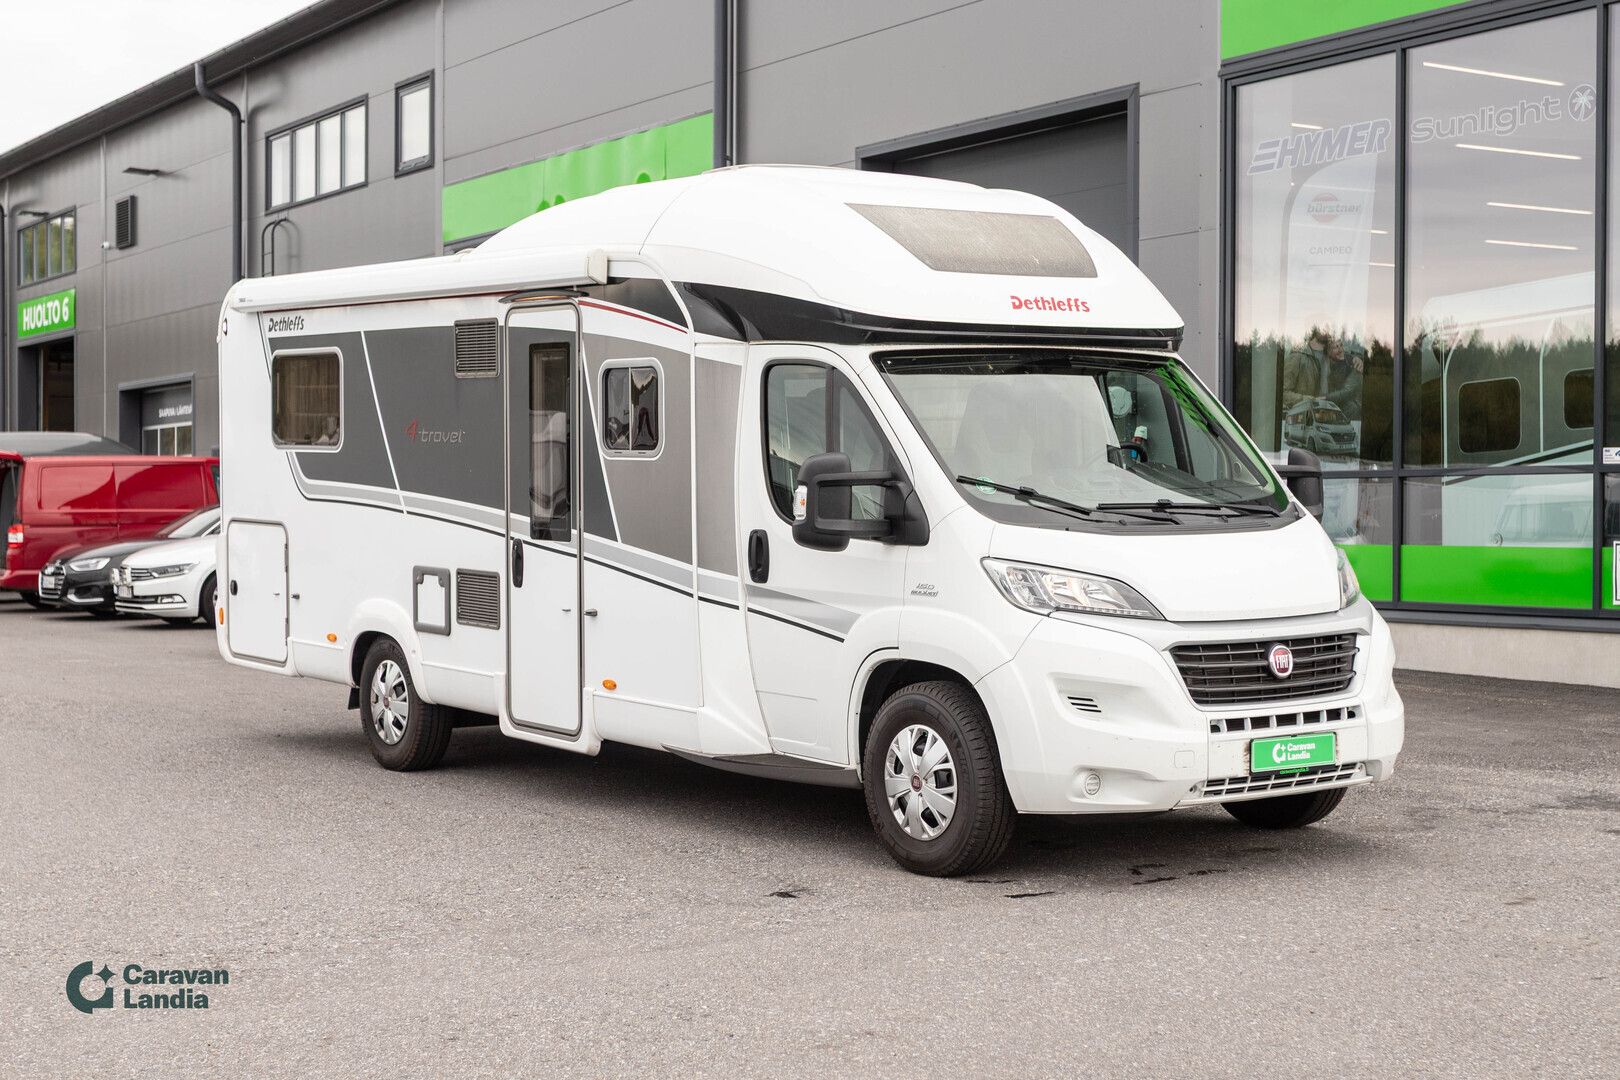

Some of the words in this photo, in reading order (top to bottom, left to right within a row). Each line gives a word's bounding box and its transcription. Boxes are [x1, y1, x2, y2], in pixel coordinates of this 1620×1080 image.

[1411, 95, 1561, 144] Sunlight
[1272, 118, 1392, 171] HYMER
[1306, 202, 1362, 214] bürstner
[1309, 246, 1353, 256] CAMPEO
[1010, 295, 1091, 313] Dethleffs
[22, 298, 61, 332] HUOLTO
[62, 297, 70, 322] 6
[268, 315, 305, 333] Dethleffs
[1275, 654, 1290, 668] FIAT
[1287, 743, 1316, 752] Caravan
[1287, 751, 1310, 760] Landia
